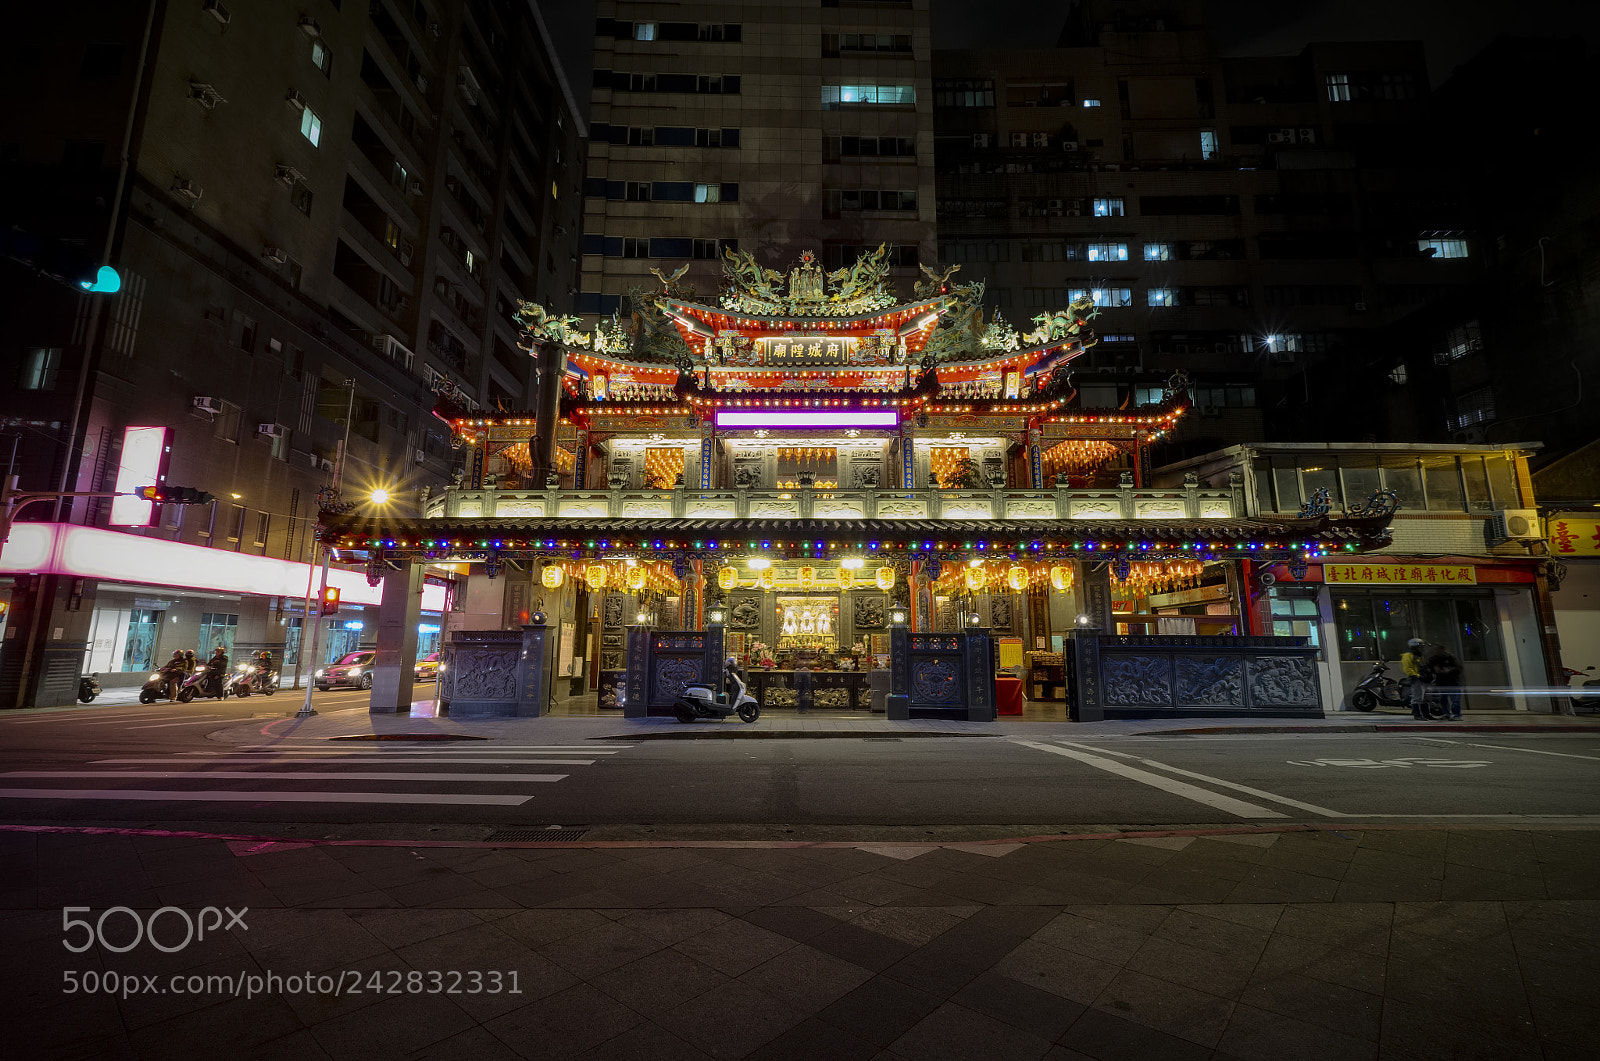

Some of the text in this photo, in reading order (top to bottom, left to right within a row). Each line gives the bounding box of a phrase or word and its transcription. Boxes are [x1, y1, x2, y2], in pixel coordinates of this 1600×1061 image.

[1328, 566, 1472, 581] 臺北府城隍廟普化殿
